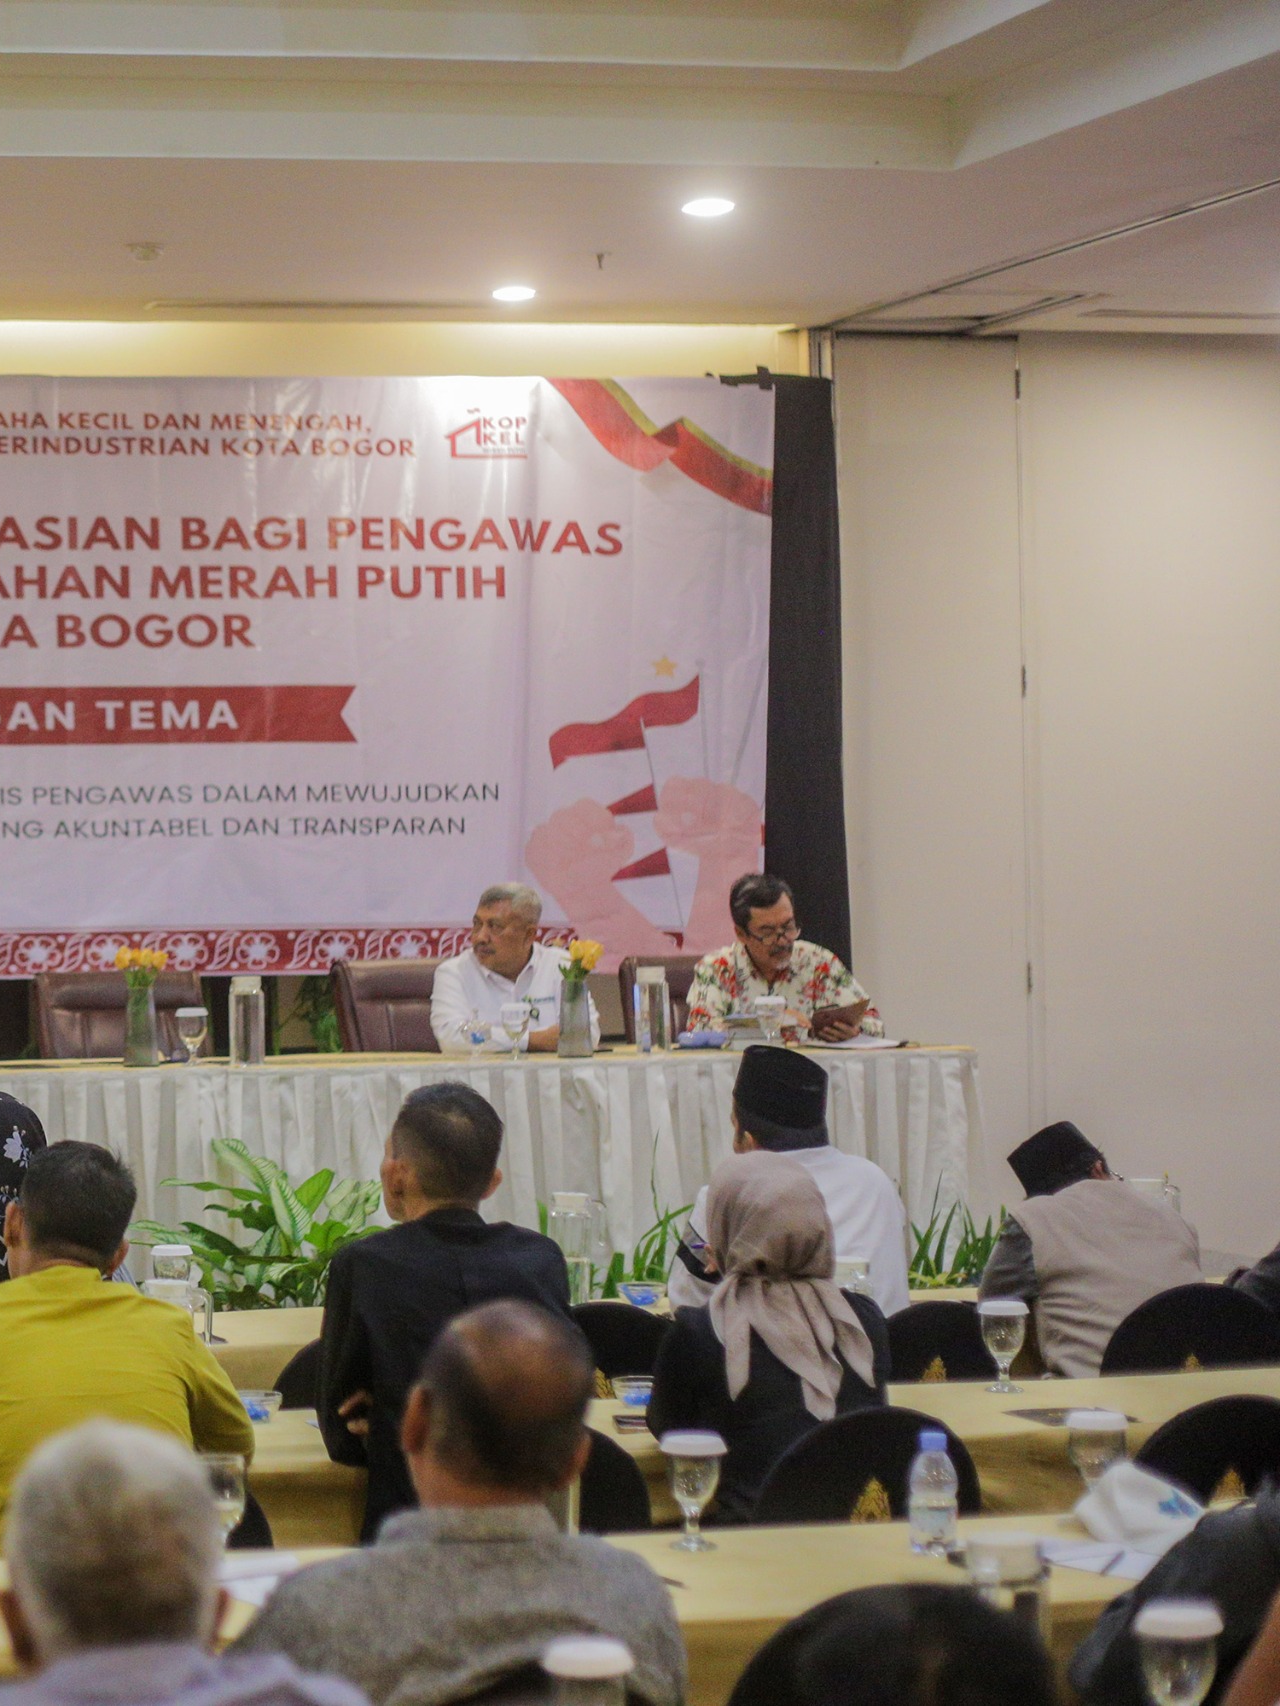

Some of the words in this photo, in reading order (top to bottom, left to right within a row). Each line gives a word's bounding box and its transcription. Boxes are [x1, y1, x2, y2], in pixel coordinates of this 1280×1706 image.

[58, 412, 134, 430] KECIL
[143, 413, 201, 431] DAN
[211, 412, 373, 433] MENENGAH,
[483, 416, 528, 430] KOP
[221, 437, 301, 457] KOTA
[311, 437, 415, 457] BOGOR
[483, 432, 526, 445] KEL
[181, 517, 307, 551] BAGI
[328, 517, 623, 556] PENGAWAS
[150, 565, 337, 599] MERAH
[357, 565, 506, 599] PUTIH
[57, 613, 254, 649] BOGOR
[96, 700, 238, 730] TEMA
[32, 786, 192, 805] PENGAWAS
[202, 784, 298, 804] DALAM
[306, 783, 500, 804] MEWUJUDKAN
[54, 818, 212, 838] AKUNTABEL
[222, 817, 280, 837] DAN
[290, 817, 466, 837] TRANSPARAN
